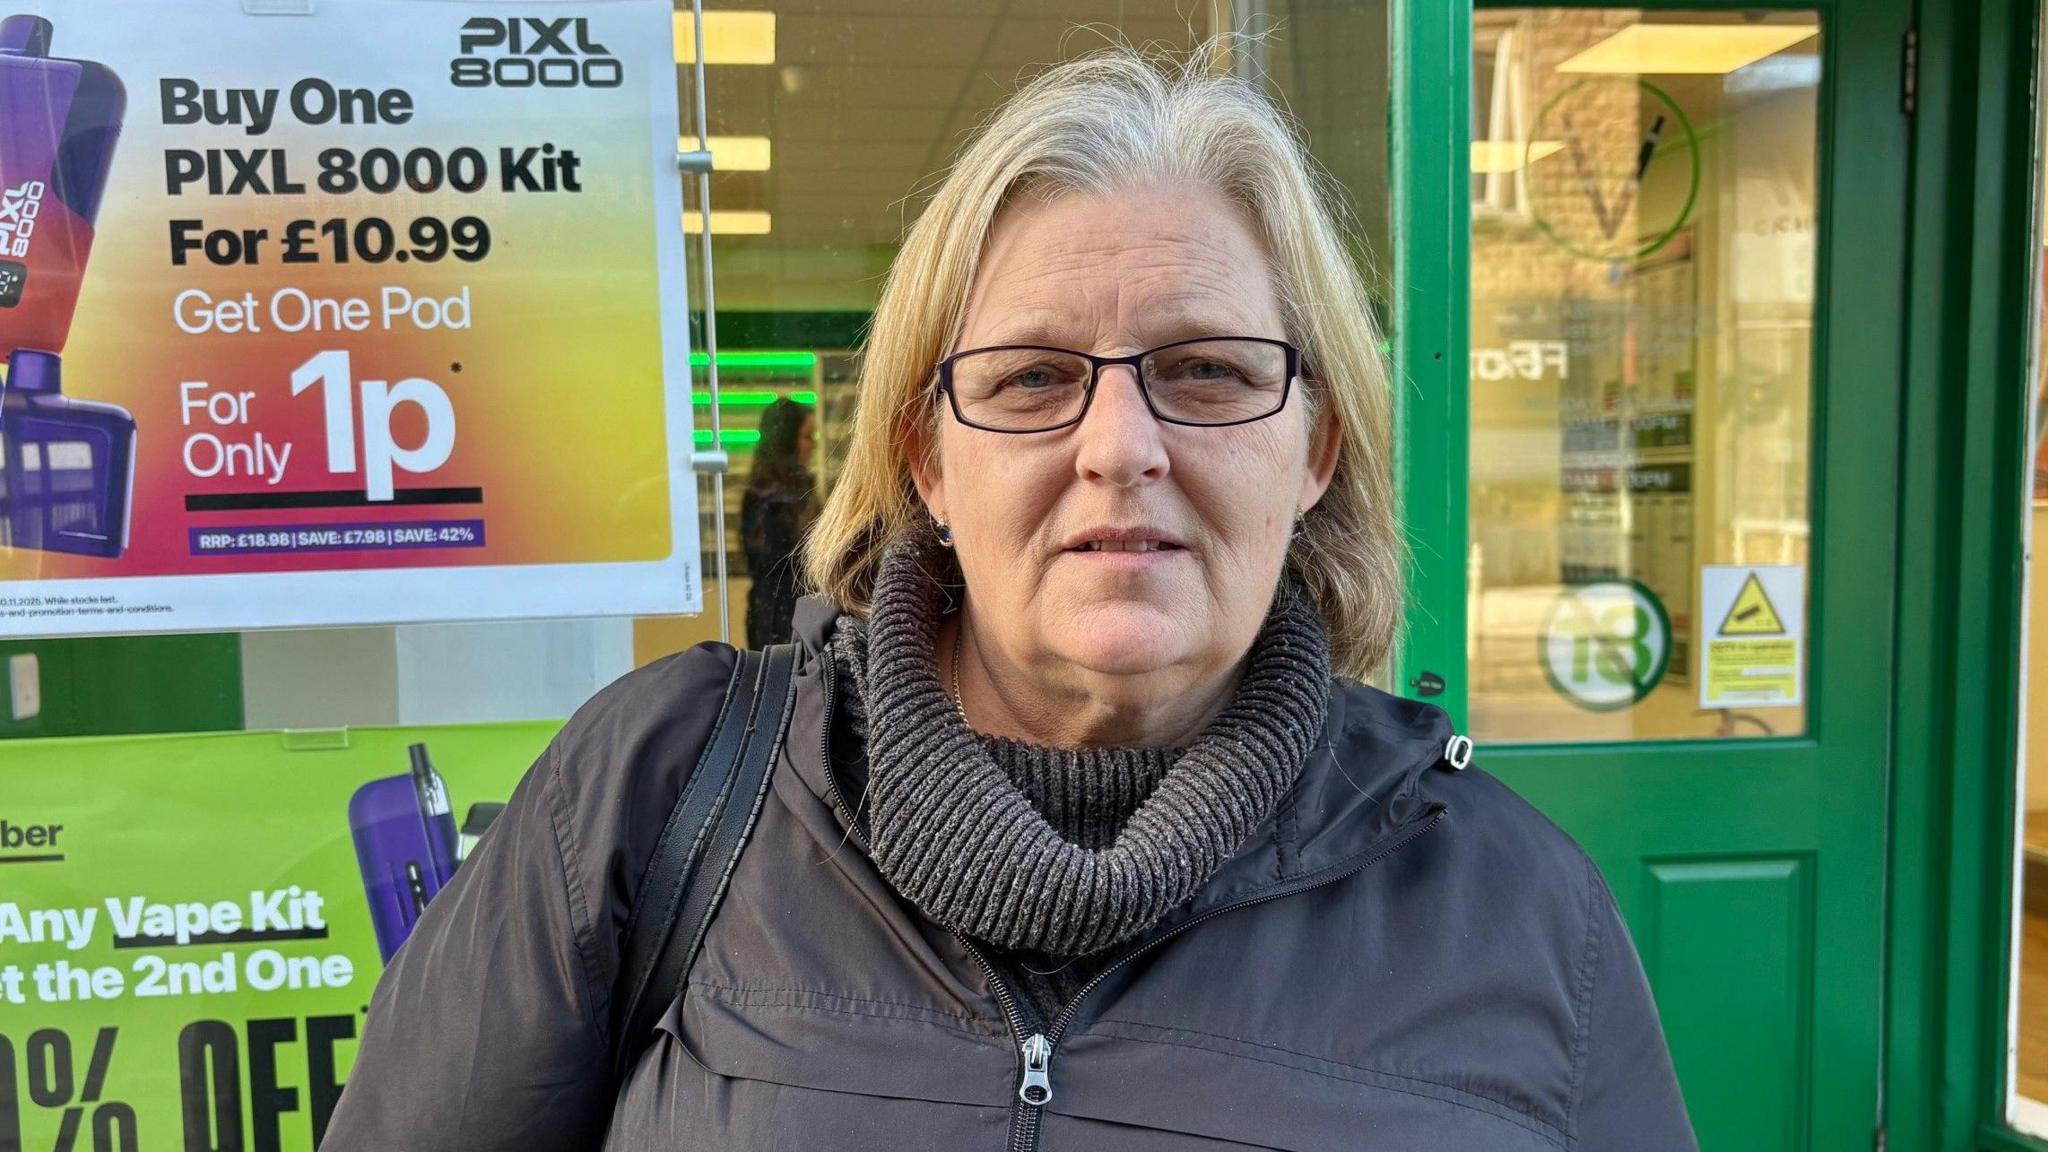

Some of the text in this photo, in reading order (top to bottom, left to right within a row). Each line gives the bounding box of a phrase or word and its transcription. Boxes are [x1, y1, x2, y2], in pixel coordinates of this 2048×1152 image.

[460, 17, 612, 56] PIXL
[450, 58, 624, 88] 8000
[160, 77, 414, 136] Buy One
[164, 142, 582, 195] PIXL 8000 Kit
[11, 181, 45, 257] 8000
[169, 216, 492, 265] For £10.99
[173, 285, 471, 334] Get One Pod
[180, 381, 255, 425] For
[183, 432, 292, 485] Only
[200, 534, 236, 549] RRP:
[238, 533, 290, 548] £18.98
[298, 531, 342, 546] SAVE:
[344, 530, 385, 545] £7.98
[394, 529, 437, 543] SAVE:
[439, 527, 474, 542] 42%
[44, 596, 69, 605] While
[71, 596, 98, 605] stocks
[0, 885, 326, 950] Any Vape Kit
[0, 949, 353, 1004] t the 2nd One
